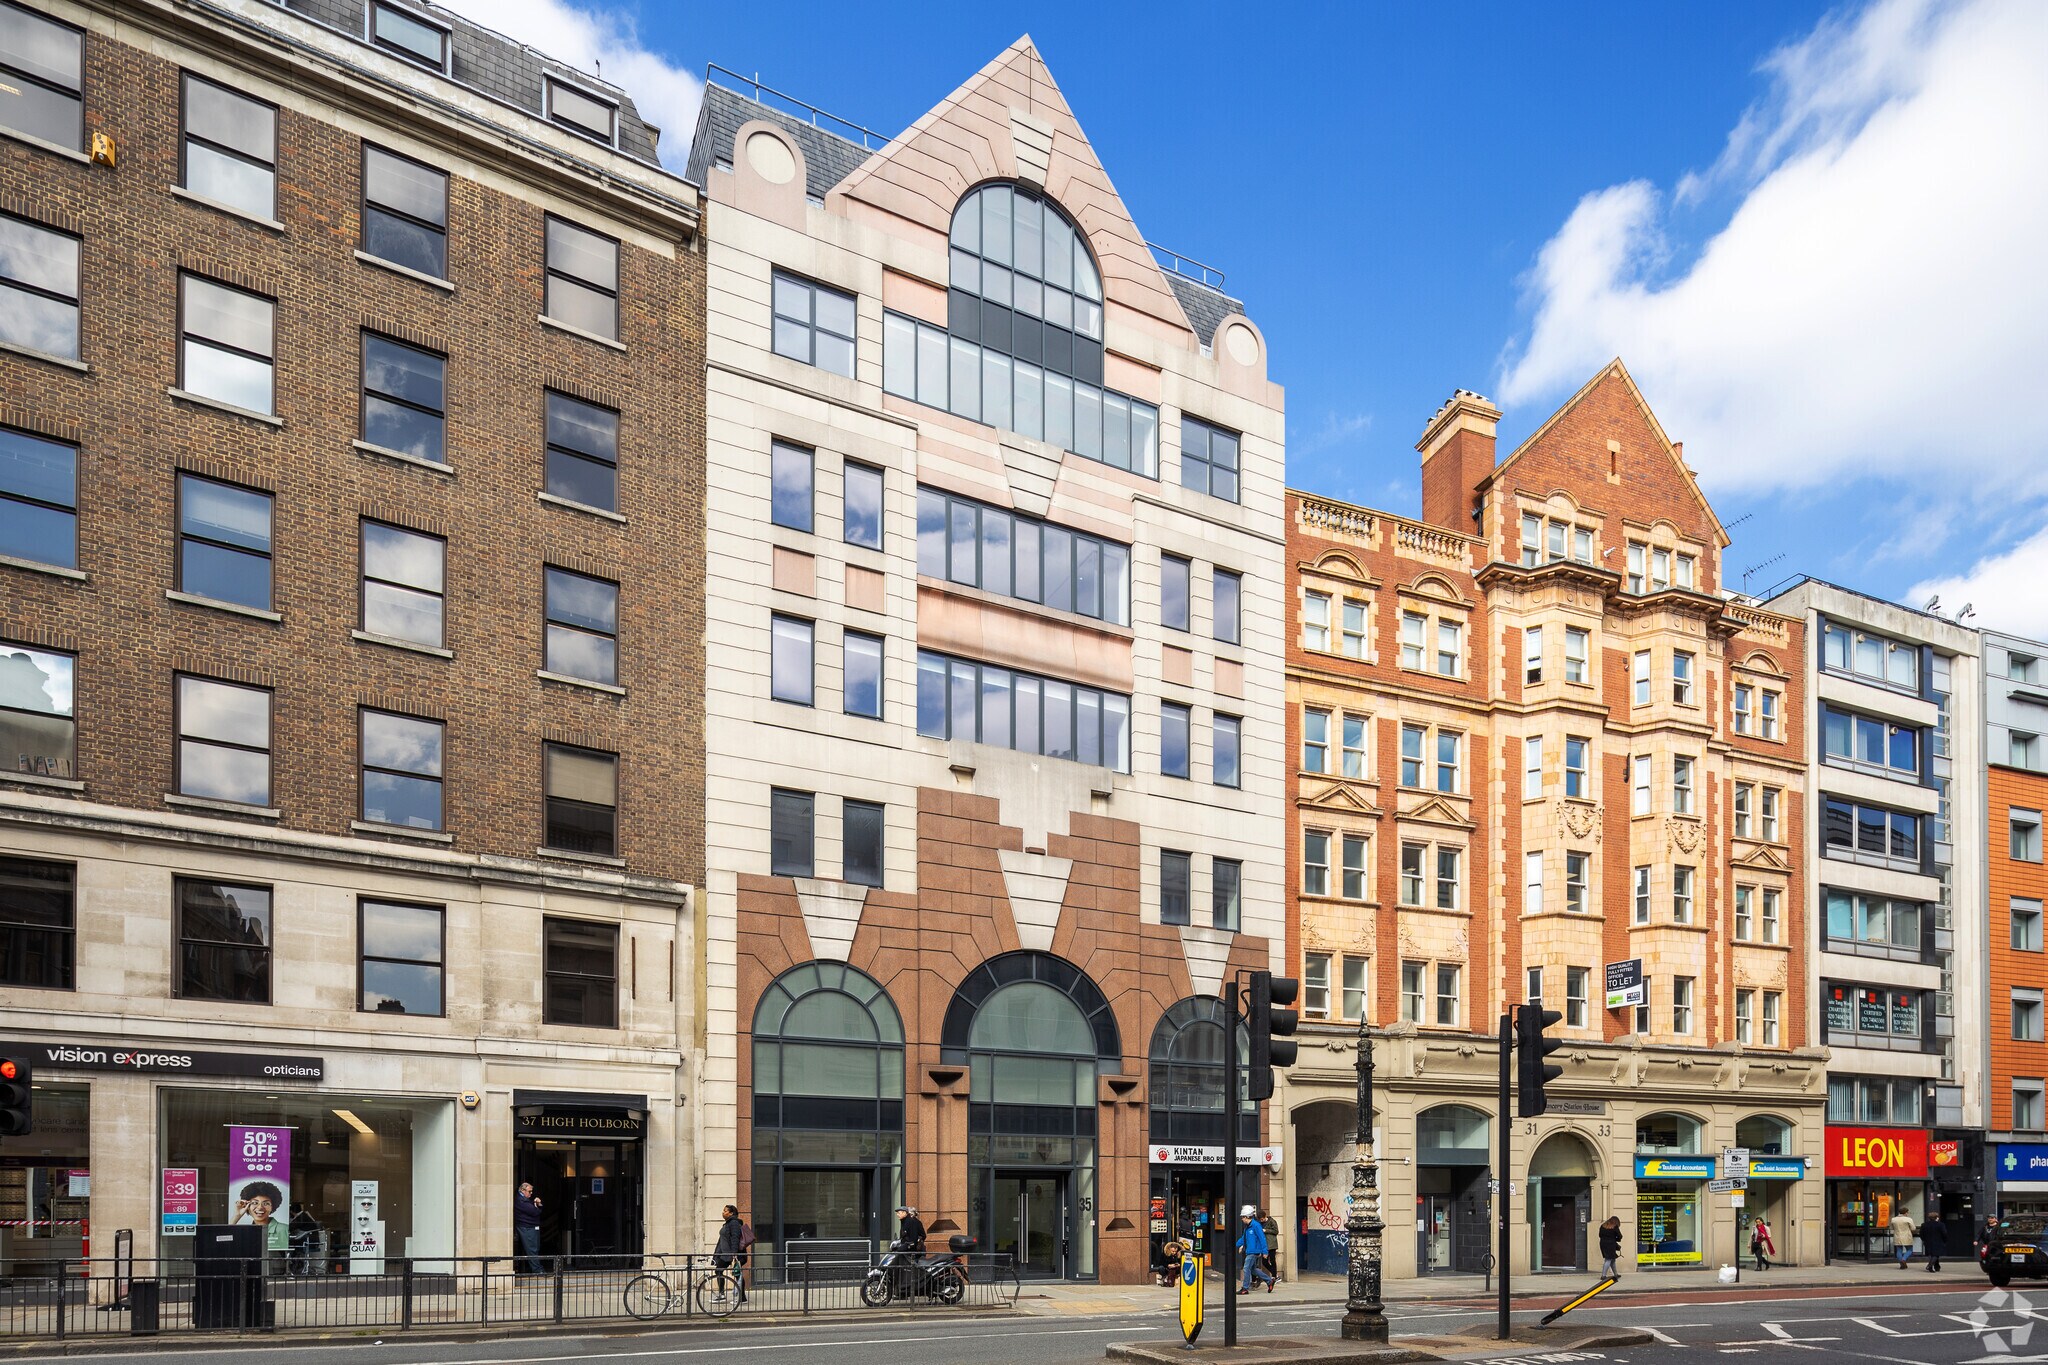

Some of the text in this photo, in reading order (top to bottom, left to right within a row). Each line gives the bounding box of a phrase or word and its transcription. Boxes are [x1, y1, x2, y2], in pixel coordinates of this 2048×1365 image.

[1620, 976, 1634, 986] LET
[47, 1046, 192, 1068] vision express
[264, 1064, 320, 1076] opticians
[1563, 1102, 1582, 1112] Station
[522, 1116, 640, 1130] 37 HIGH HOLBORN
[1525, 1122, 1538, 1136] 31
[1598, 1124, 1611, 1137] 33
[244, 1131, 278, 1144] 50%
[242, 1144, 278, 1157] OFF
[1174, 1148, 1204, 1156] KINTAN
[1842, 1138, 1904, 1168] LEON
[1931, 1143, 1954, 1151] LEON
[166, 1183, 195, 1195] £39
[973, 1197, 986, 1212] 35
[1079, 1197, 1092, 1212] 35
